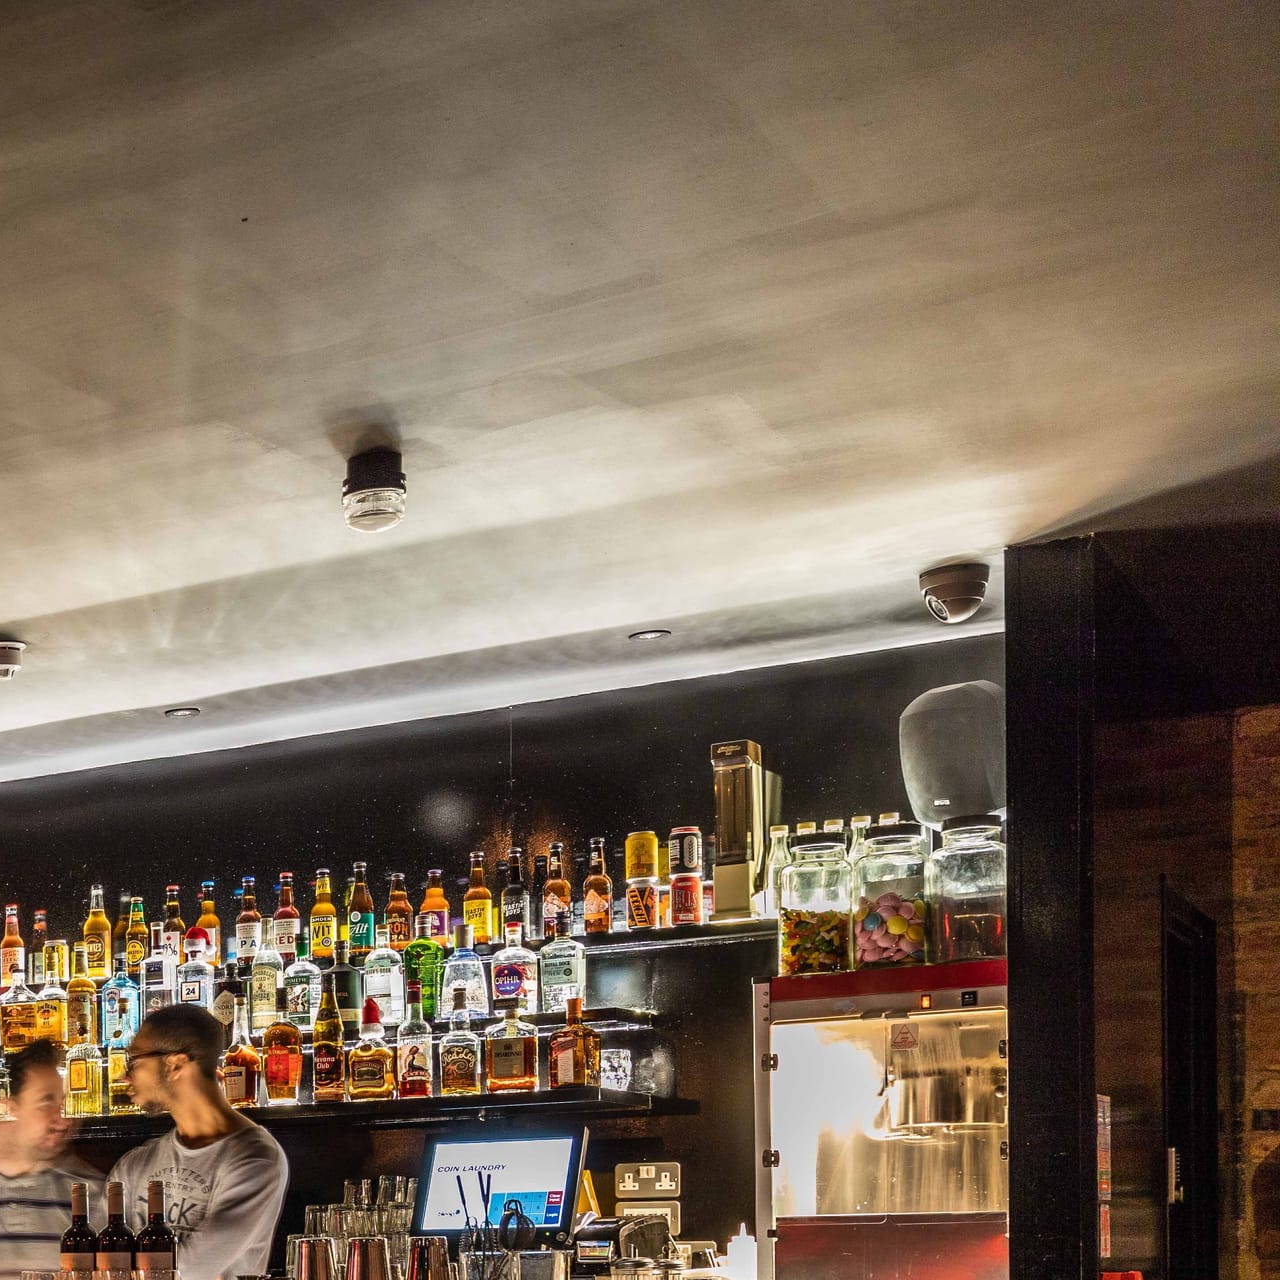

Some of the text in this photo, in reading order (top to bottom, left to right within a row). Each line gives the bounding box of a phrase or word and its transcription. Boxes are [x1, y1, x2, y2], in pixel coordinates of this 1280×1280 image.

[185, 987, 196, 996] 24
[437, 1164, 507, 1173] COIN LAUNDRY
